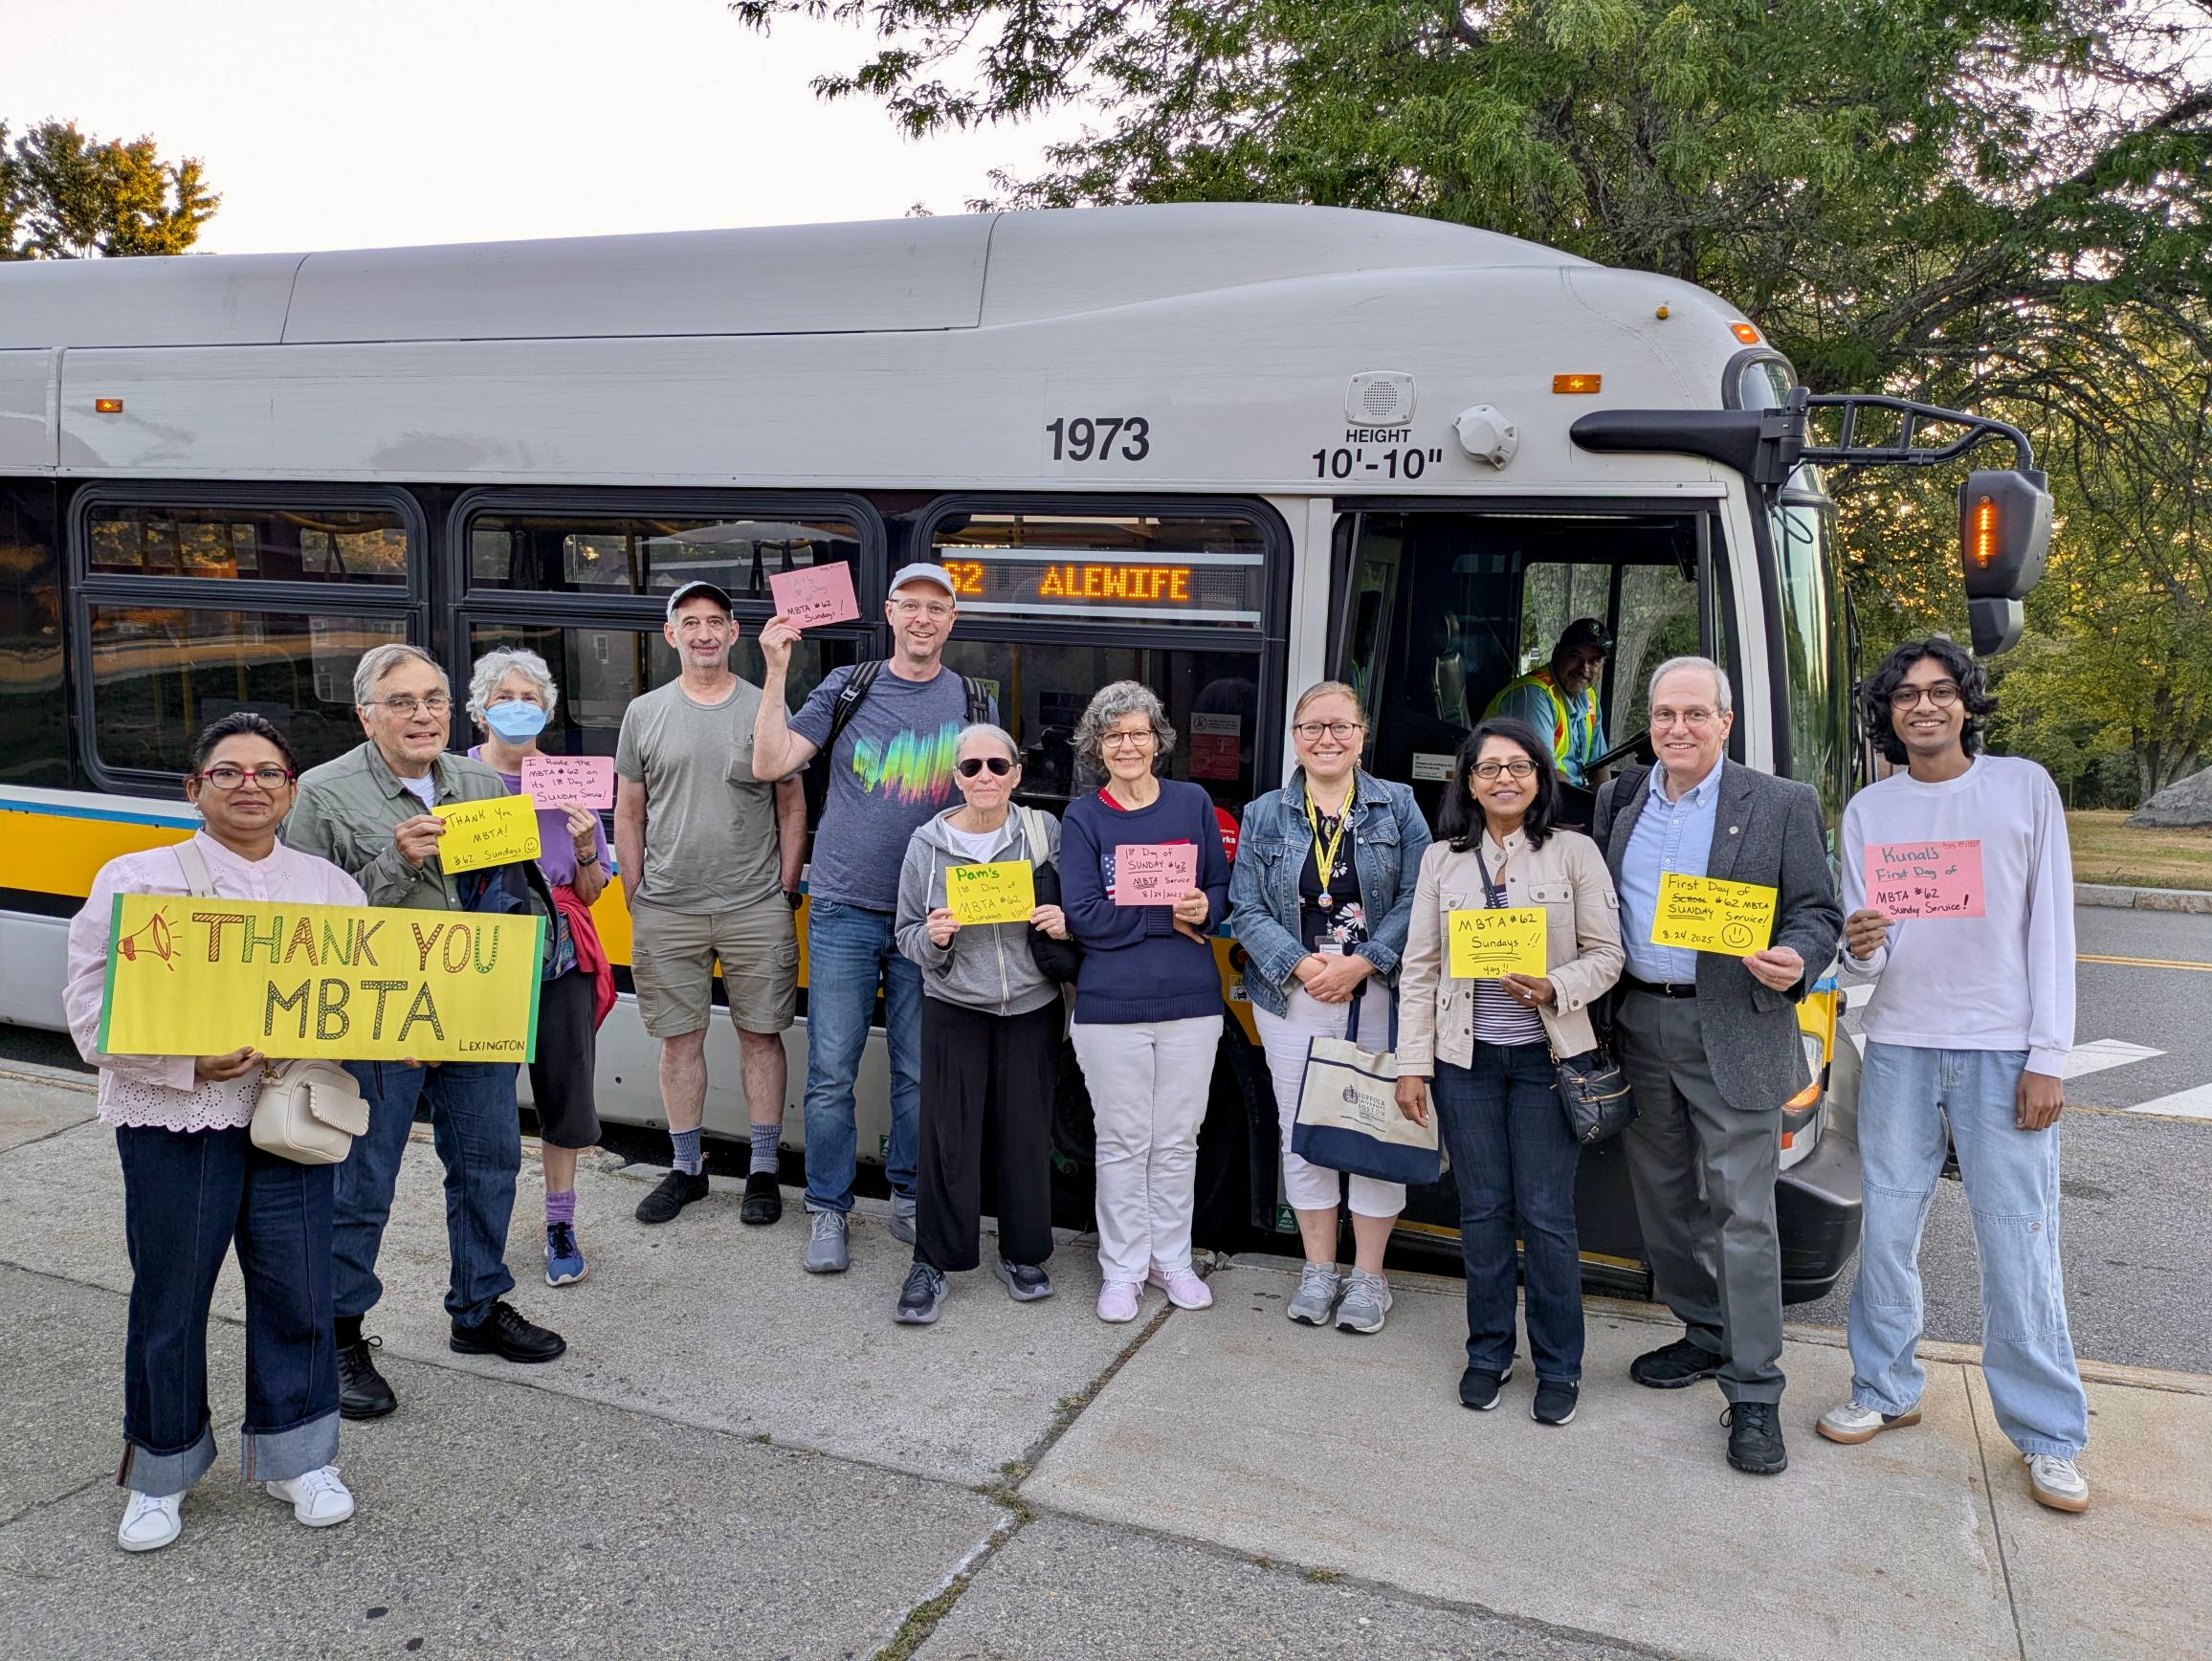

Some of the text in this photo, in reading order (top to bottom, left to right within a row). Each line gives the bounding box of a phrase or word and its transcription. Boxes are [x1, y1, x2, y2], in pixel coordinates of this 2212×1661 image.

[1046, 416, 1150, 462] 1973
[1345, 429, 1411, 443] HEIGHT
[1312, 448, 1443, 479] 10'-10"
[1040, 565, 1190, 600] ALEWIFE
[787, 604, 811, 616] MBTA
[805, 611, 835, 622] Sundays
[567, 777, 584, 786] Day
[445, 809, 486, 828] THANK
[473, 825, 508, 844] MBTA!
[453, 847, 521, 866] #62 Sundays
[1141, 848, 1158, 859] Day
[1162, 848, 1173, 857] of
[1881, 847, 1939, 864] Kunal's
[1128, 860, 1164, 870] SUNDAY
[1875, 864, 1958, 880] First Day of
[956, 867, 1000, 881] Pam's
[1133, 876, 1158, 886] MBTA
[981, 883, 1001, 894] Day
[1007, 880, 1016, 889] of
[1668, 874, 1751, 896] First Day of
[1741, 900, 1769, 910] MBTA
[1875, 890, 1910, 905] MBTA
[959, 898, 996, 915] MBTA
[1668, 903, 1714, 919] SUNDAY
[1889, 904, 1920, 918] Sunday
[967, 913, 1002, 922] Sundays
[1458, 913, 1537, 932] MBTA #62
[191, 912, 500, 973] THANK YOU
[1471, 936, 1519, 954] Sundays
[264, 978, 445, 1042] MBTA
[458, 1038, 526, 1053] LEXINGTON
[1358, 1092, 1385, 1107] SUFFOLK
[1358, 1103, 1385, 1117] BOSTON
